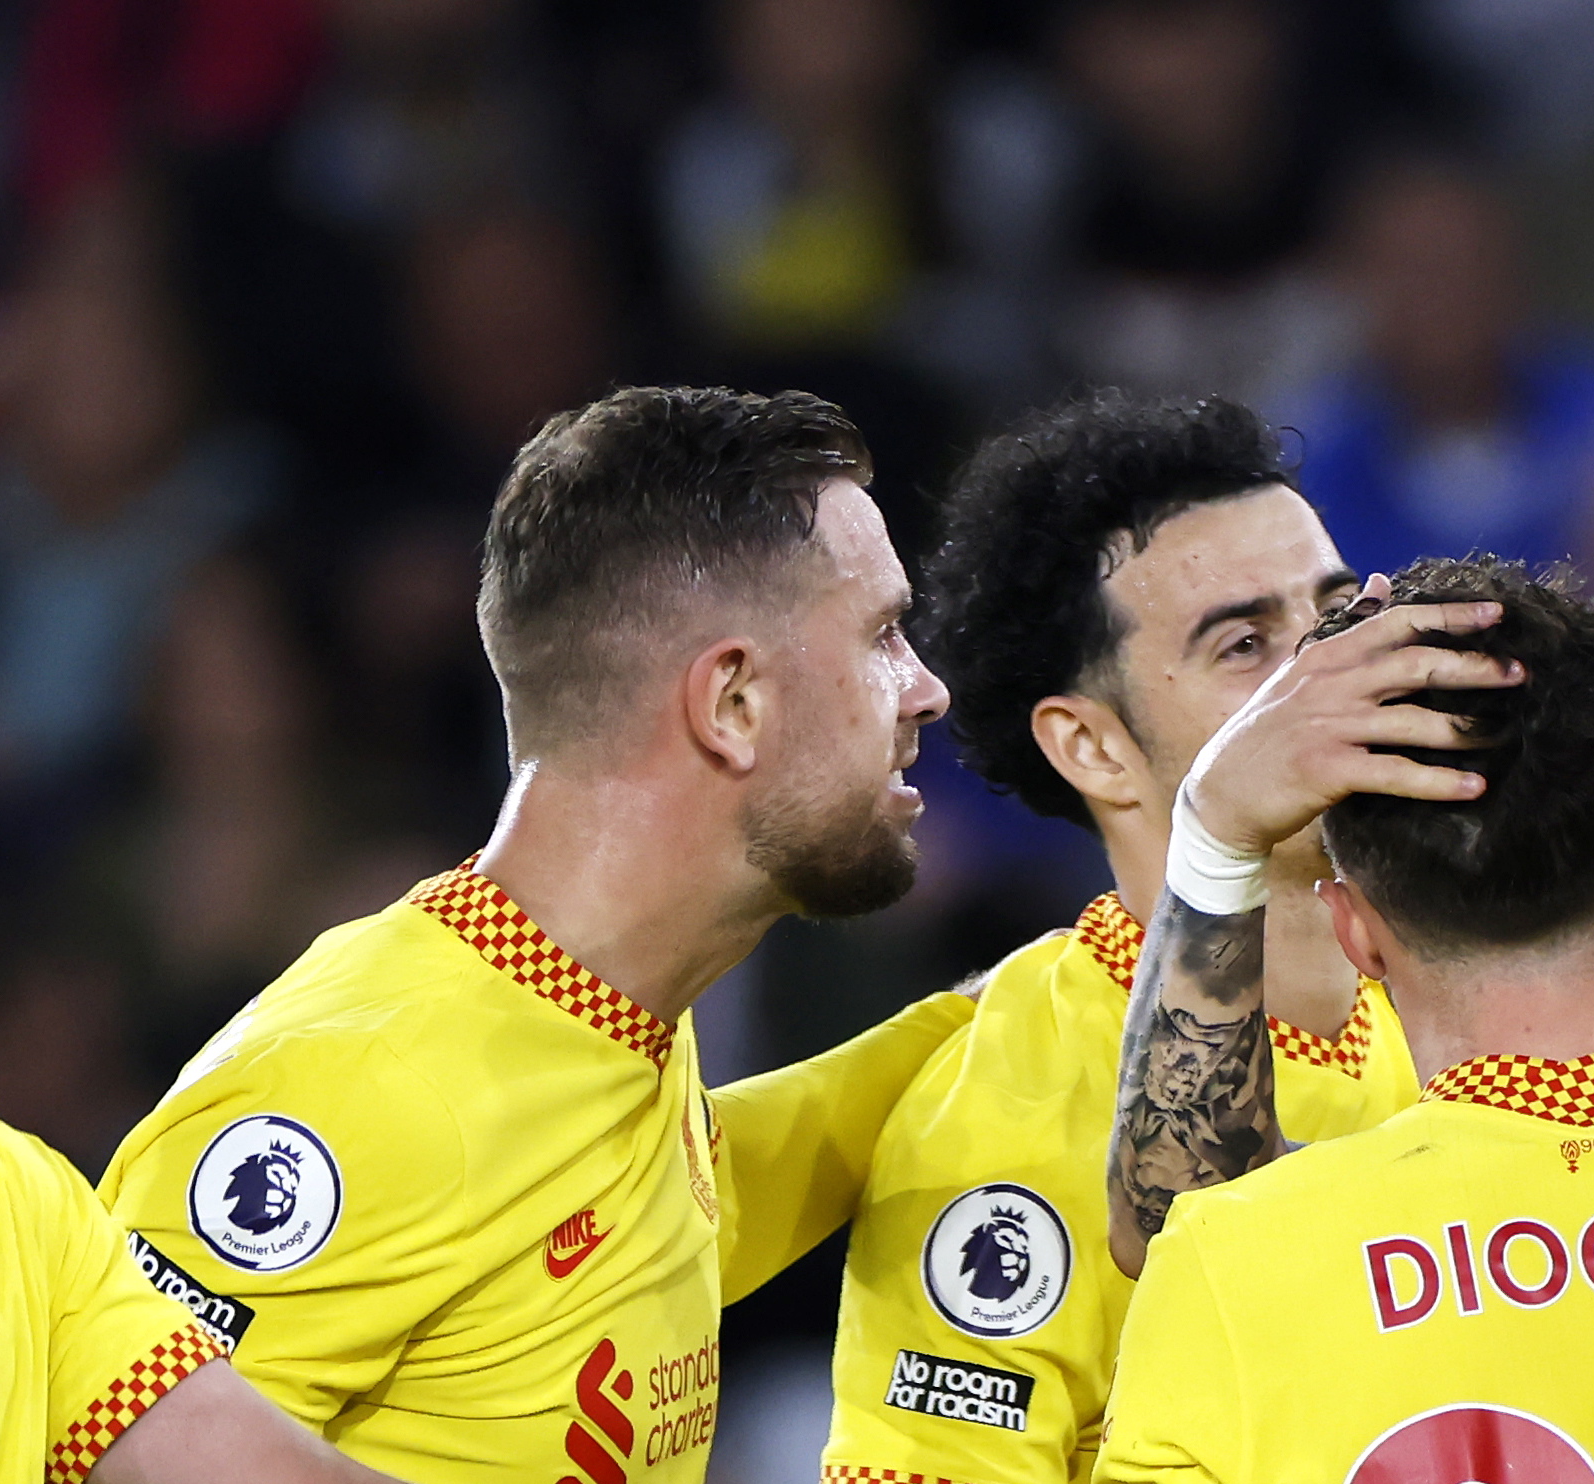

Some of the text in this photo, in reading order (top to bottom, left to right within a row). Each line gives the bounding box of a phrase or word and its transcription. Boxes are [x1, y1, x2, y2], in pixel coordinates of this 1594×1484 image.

[221, 1219, 312, 1256] Premier League
[156, 1267, 236, 1329] room
[969, 1274, 1051, 1323] Premier League
[892, 1350, 1020, 1404] No room
[885, 1377, 1027, 1432] for racism
